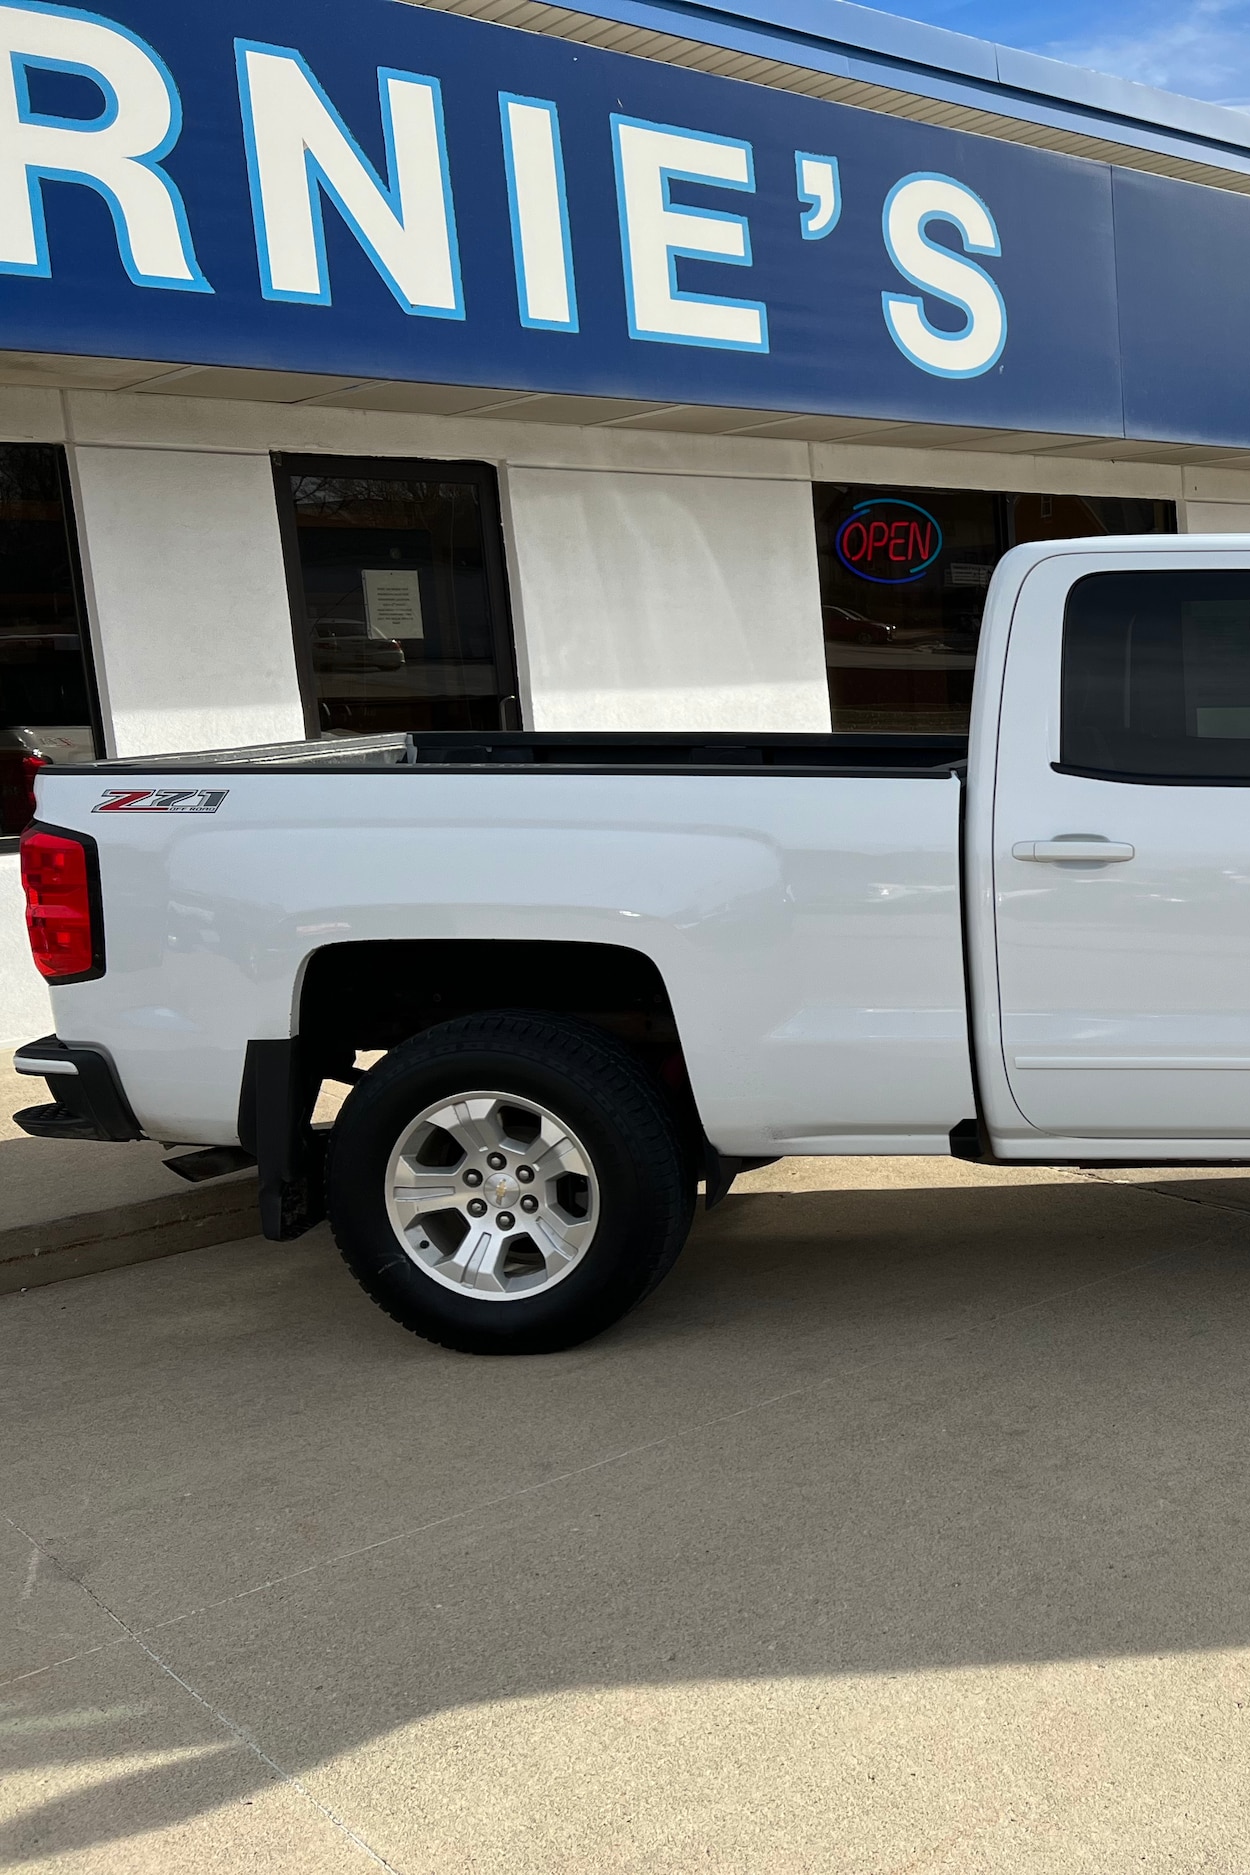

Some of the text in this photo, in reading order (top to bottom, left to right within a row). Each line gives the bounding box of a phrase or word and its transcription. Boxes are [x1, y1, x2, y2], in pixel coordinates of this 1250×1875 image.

[0, 0, 1008, 380] RNIE'S
[843, 521, 932, 561] OPEN
[90, 789, 230, 813] Z71
